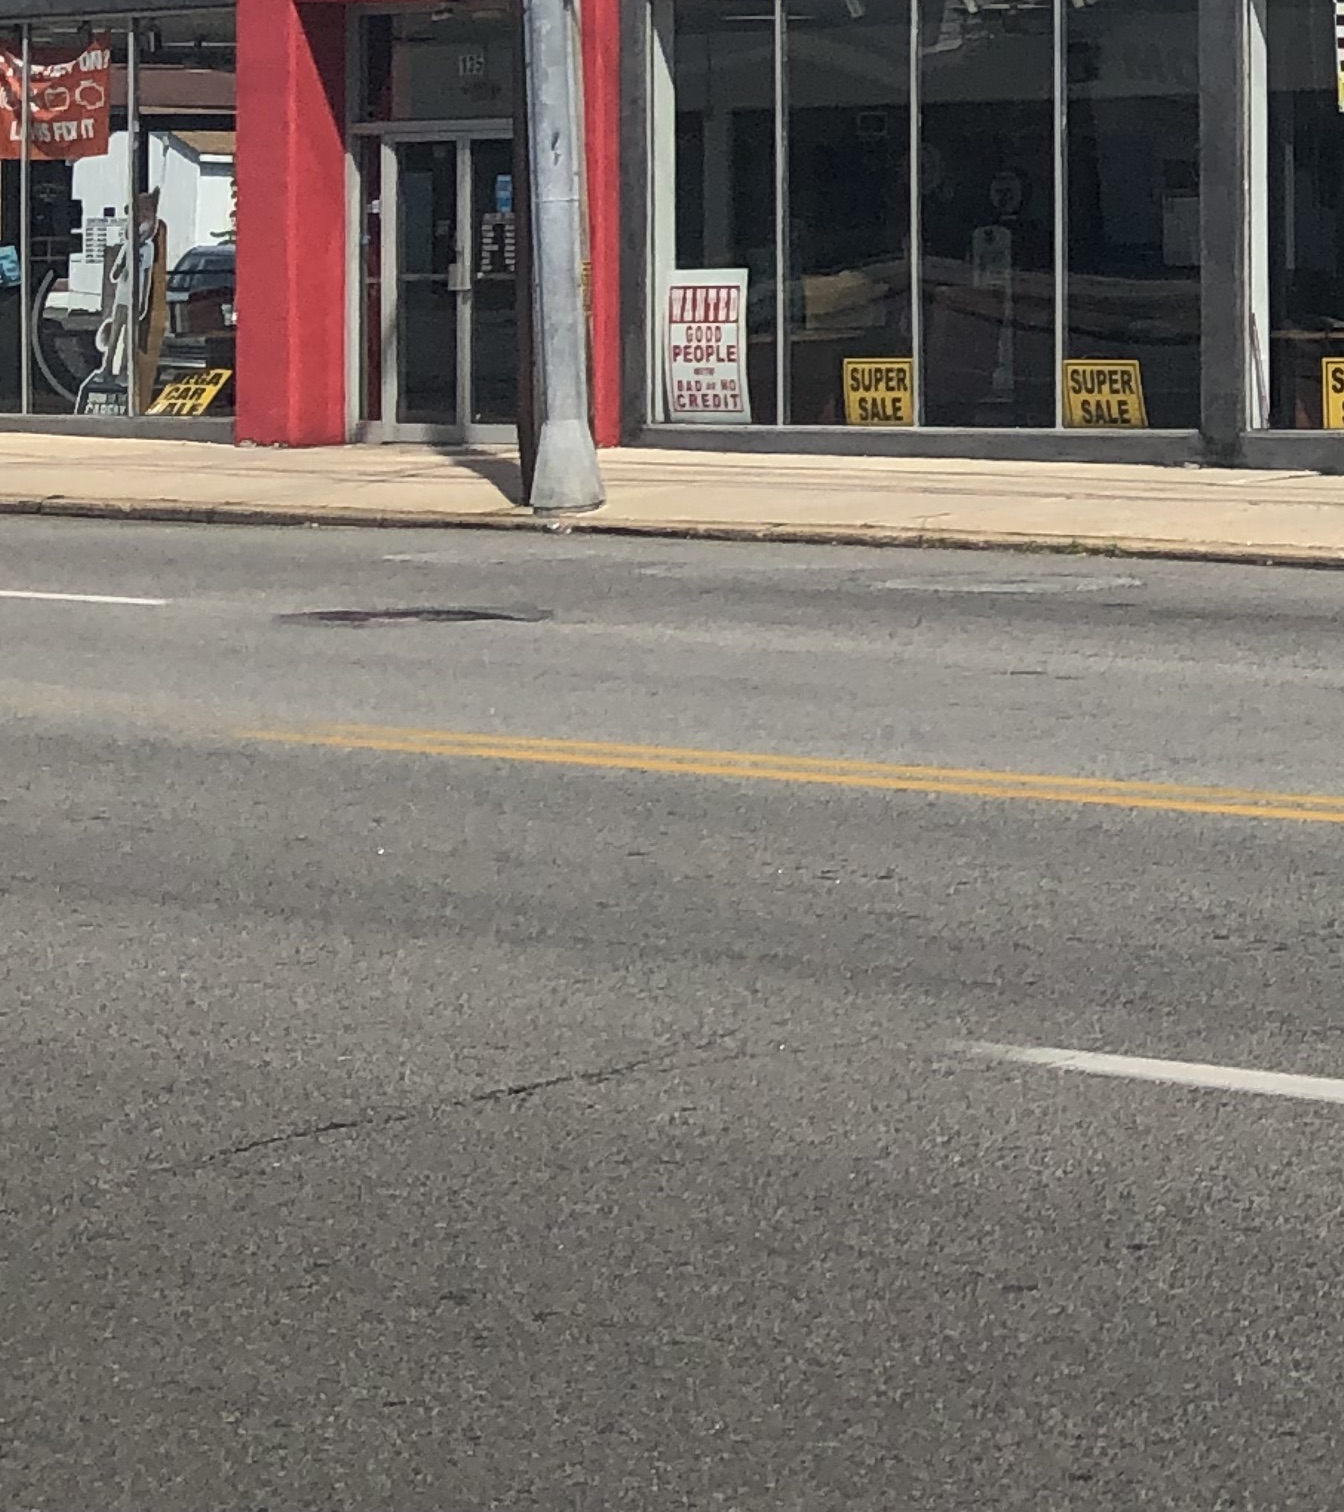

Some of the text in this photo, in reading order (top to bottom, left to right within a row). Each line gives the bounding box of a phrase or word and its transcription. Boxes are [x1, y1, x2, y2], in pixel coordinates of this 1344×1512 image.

[671, 287, 738, 322] WANTED
[685, 325, 722, 344] GOOD
[672, 344, 738, 363] PEOPLE
[677, 380, 703, 392] BAD
[849, 366, 908, 393] SUPER
[1069, 368, 1136, 395] SUPER
[164, 386, 207, 401] CAR
[676, 393, 740, 409] CREDIT
[857, 396, 904, 422] SALE
[1080, 399, 1132, 425] SALE
